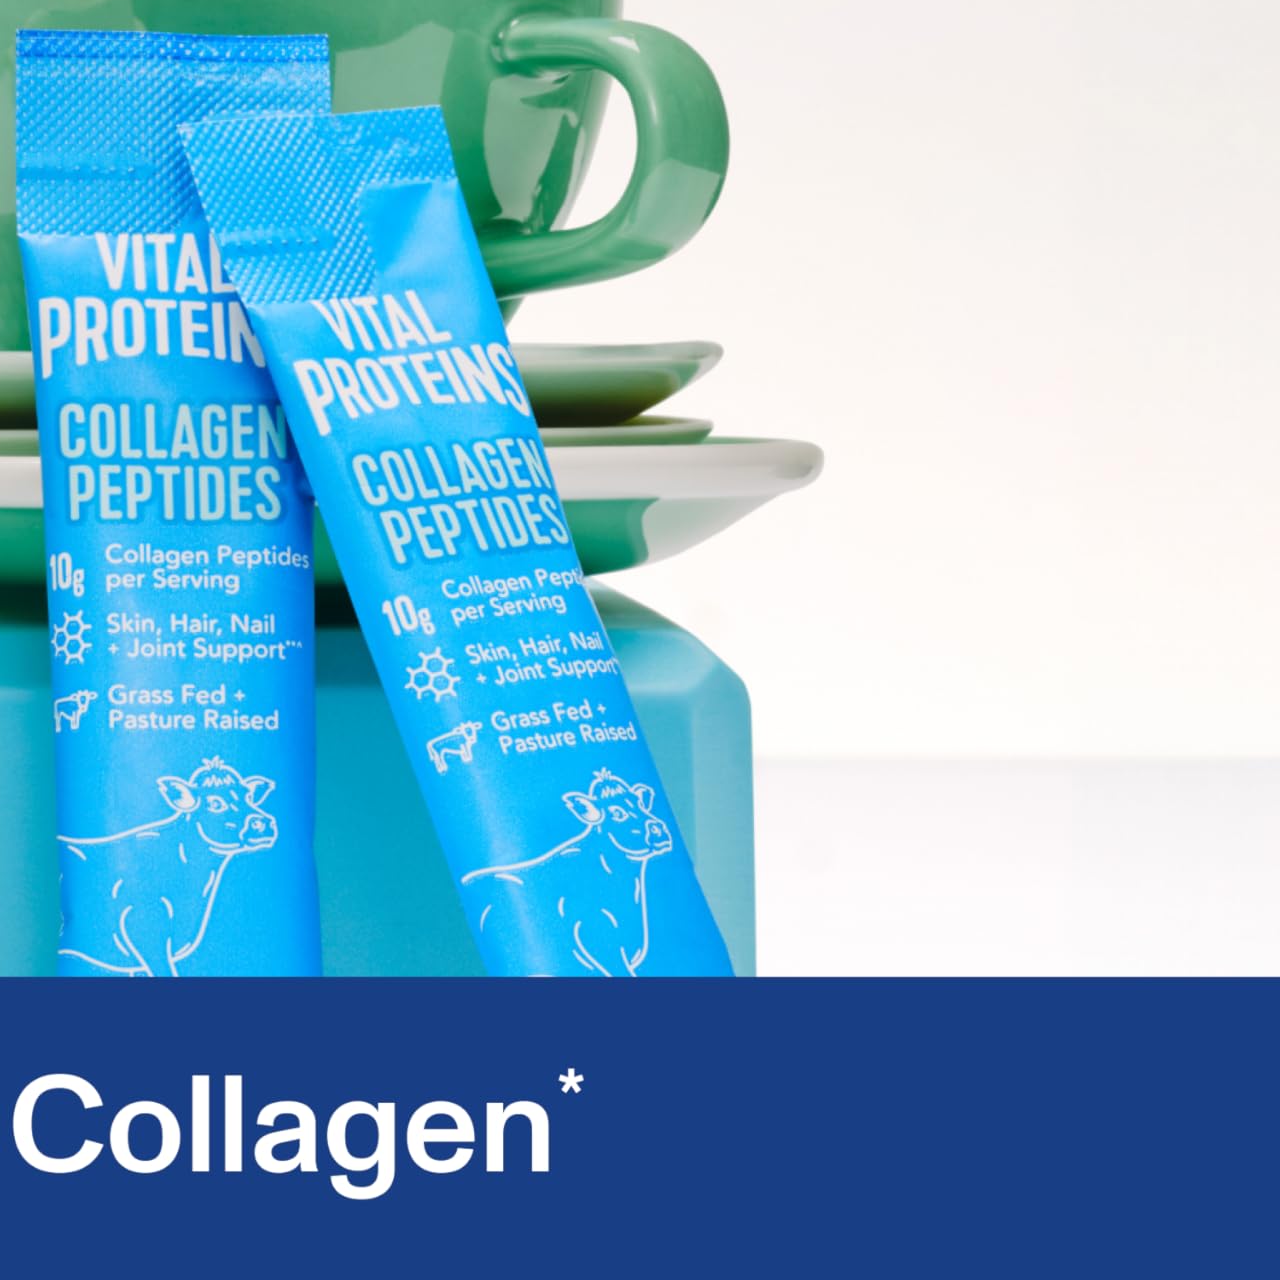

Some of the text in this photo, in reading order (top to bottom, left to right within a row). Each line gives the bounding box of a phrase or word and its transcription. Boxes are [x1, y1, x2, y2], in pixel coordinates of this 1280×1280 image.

[94, 230, 237, 294] VITAL
[37, 297, 266, 380] PROTEIN
[313, 288, 452, 354] VITAL
[60, 403, 288, 460] COLLAGEN
[351, 438, 552, 507] COLLAGEN
[69, 465, 281, 521] PEPTIDES
[379, 493, 569, 565] PEPTIDES
[105, 543, 309, 570] Collagen Peptides
[50, 552, 84, 597] 10g
[105, 569, 240, 595] per Serving
[441, 575, 533, 600] Collagen
[106, 612, 276, 637] Skin, Hair, Nail
[382, 595, 436, 637] 10g
[451, 592, 567, 627] per Serving
[127, 639, 187, 658] Joint
[465, 631, 604, 666] Skin, Hair, Nail
[495, 662, 546, 686] Joint
[108, 684, 174, 705] Grass
[181, 683, 226, 705] Fed
[109, 709, 279, 730] Pasture Raised
[491, 710, 551, 732] Grass
[552, 698, 593, 721] Fed
[498, 721, 637, 755] Pasture Raised
